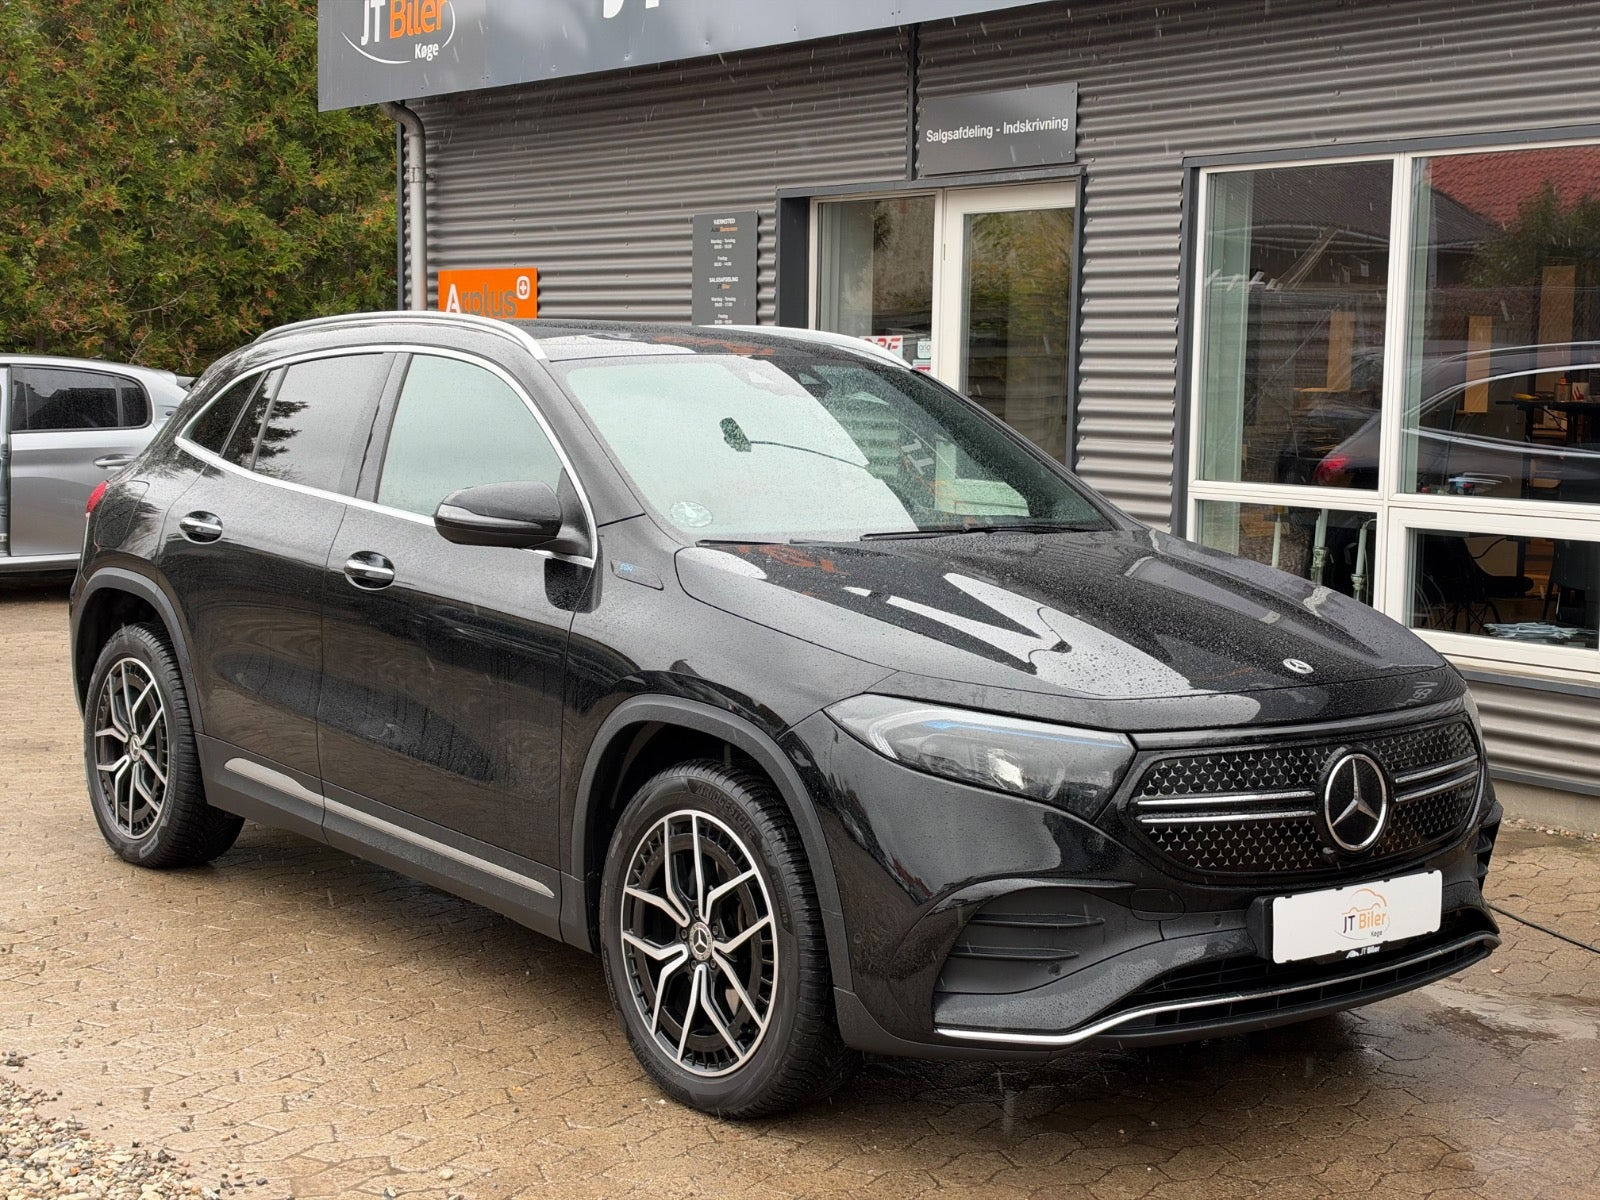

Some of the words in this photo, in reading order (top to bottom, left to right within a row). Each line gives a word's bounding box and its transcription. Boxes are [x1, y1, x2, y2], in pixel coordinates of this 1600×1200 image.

[361, 0, 386, 46] JT
[389, 0, 447, 39] Biler
[414, 43, 439, 61] Køge
[926, 125, 993, 143] Salgsafdeling
[1003, 116, 1069, 135] Indskrivning
[1343, 915, 1356, 934] JT
[1359, 911, 1386, 929] Biler
